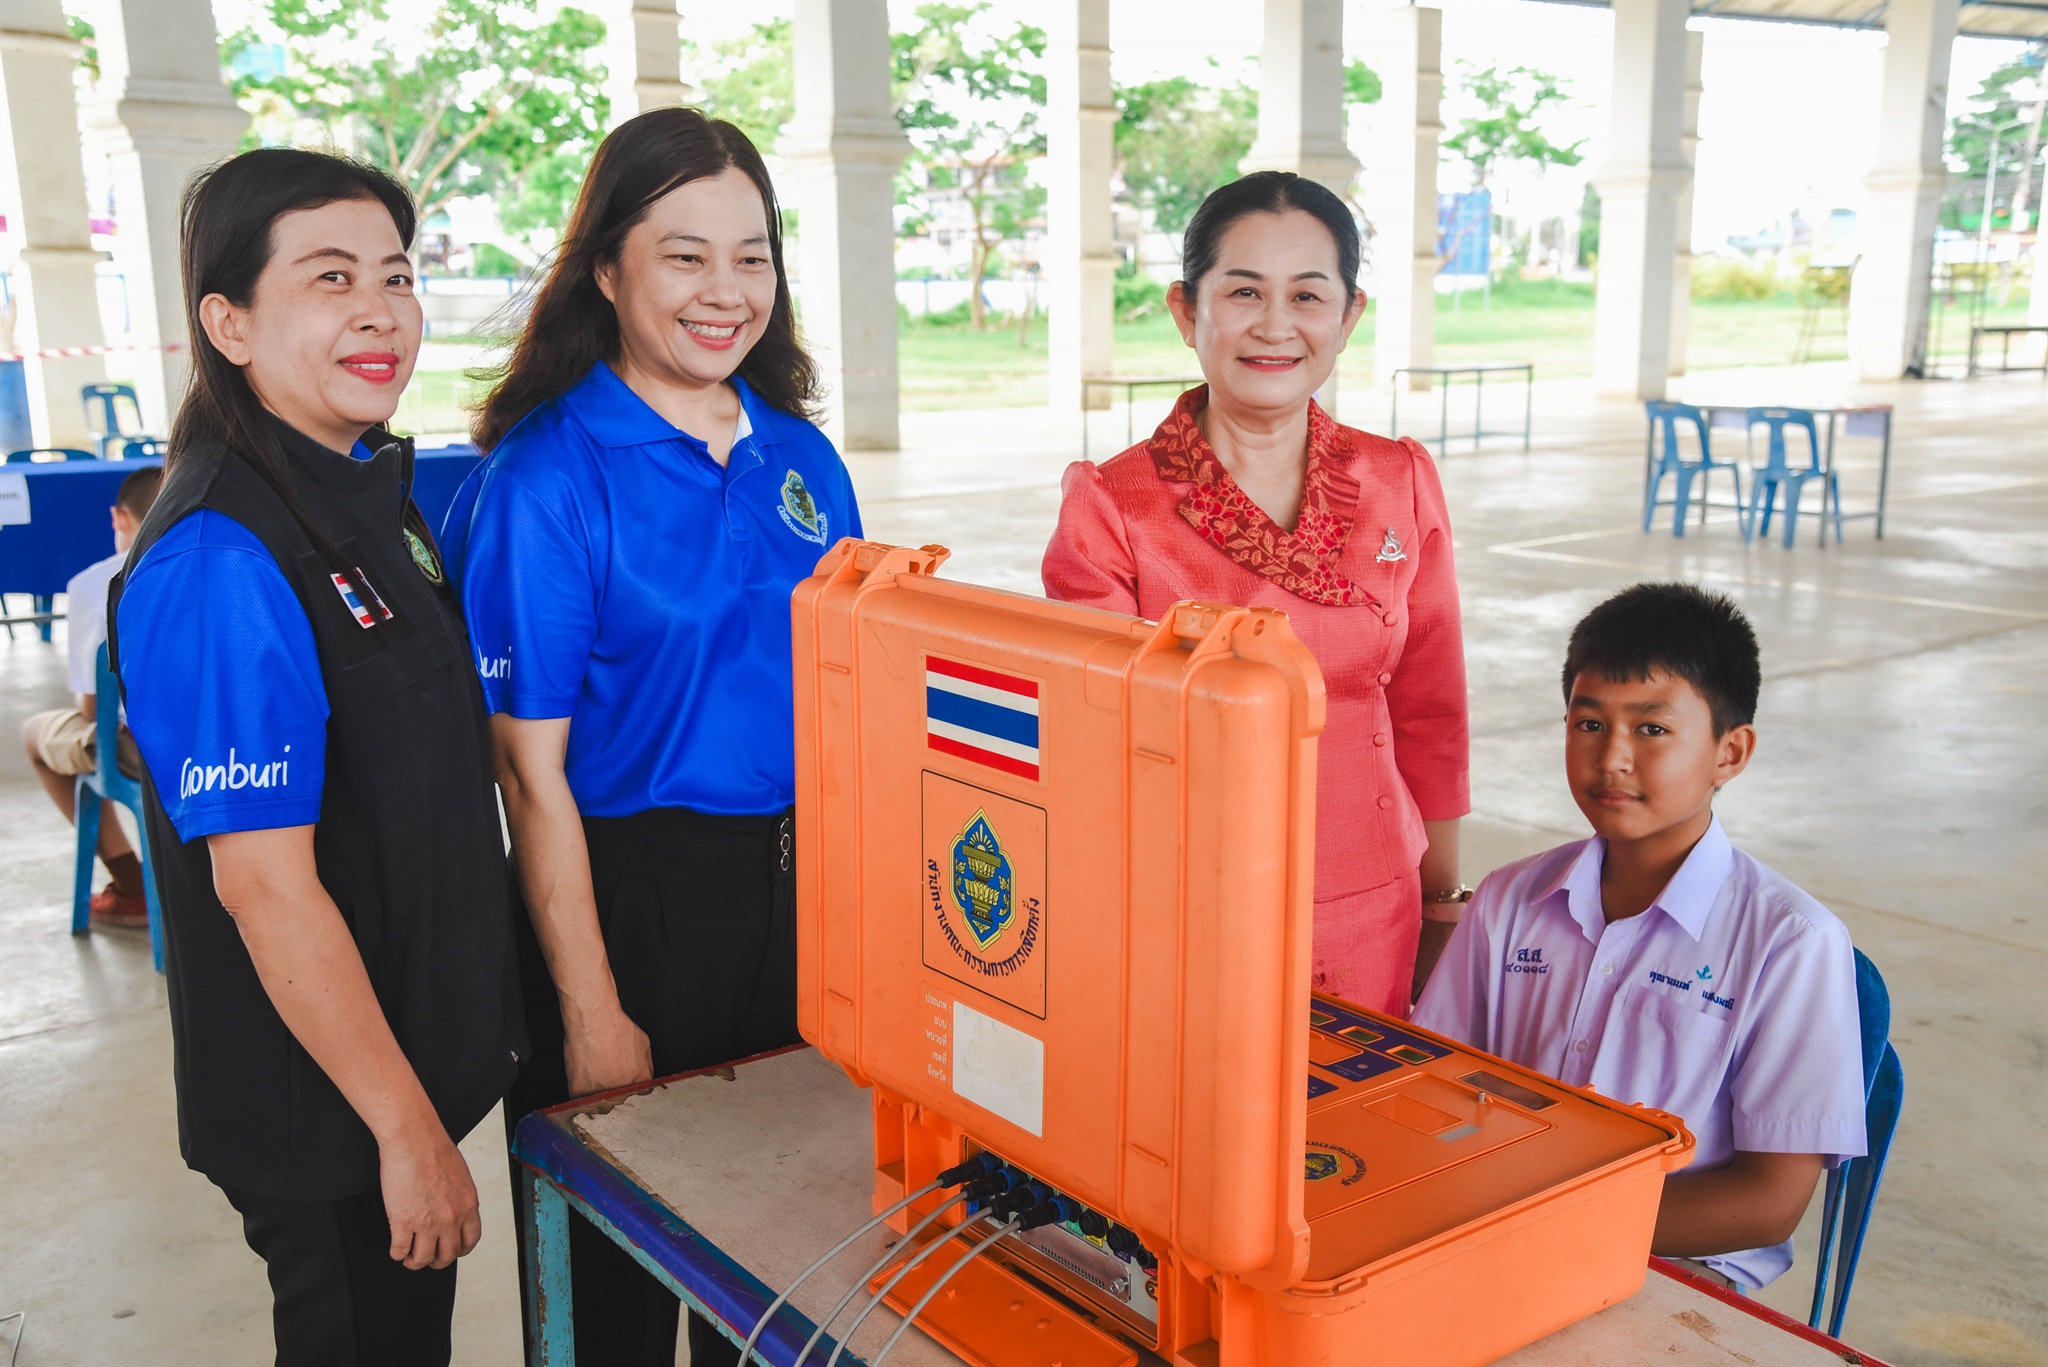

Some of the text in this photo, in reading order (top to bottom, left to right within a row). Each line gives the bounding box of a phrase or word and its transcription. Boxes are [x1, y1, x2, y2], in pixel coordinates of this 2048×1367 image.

[180, 744, 291, 801] Conburi
[927, 858, 1041, 978] สำนักงานคณะกรรมการการเลือกตั้ง
